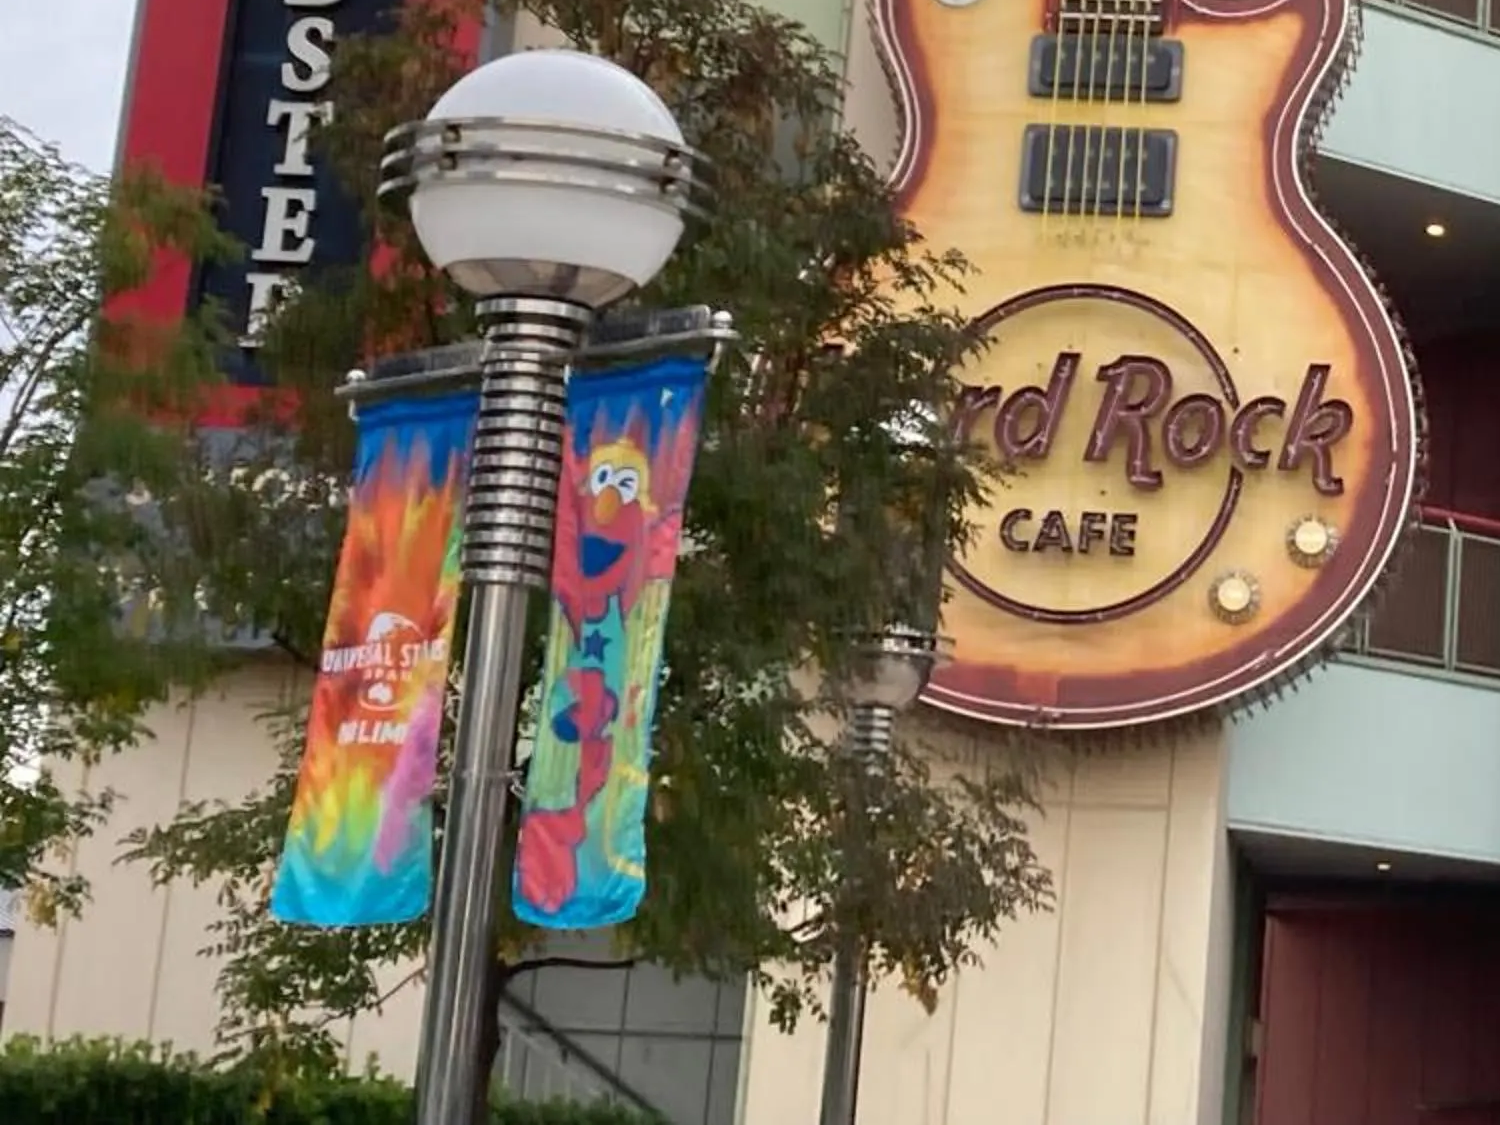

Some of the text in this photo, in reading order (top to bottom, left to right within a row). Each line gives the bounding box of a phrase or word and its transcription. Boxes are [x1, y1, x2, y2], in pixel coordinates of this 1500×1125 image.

[945, 351, 1354, 496] rd Rock
[999, 508, 1138, 557] CAFE
